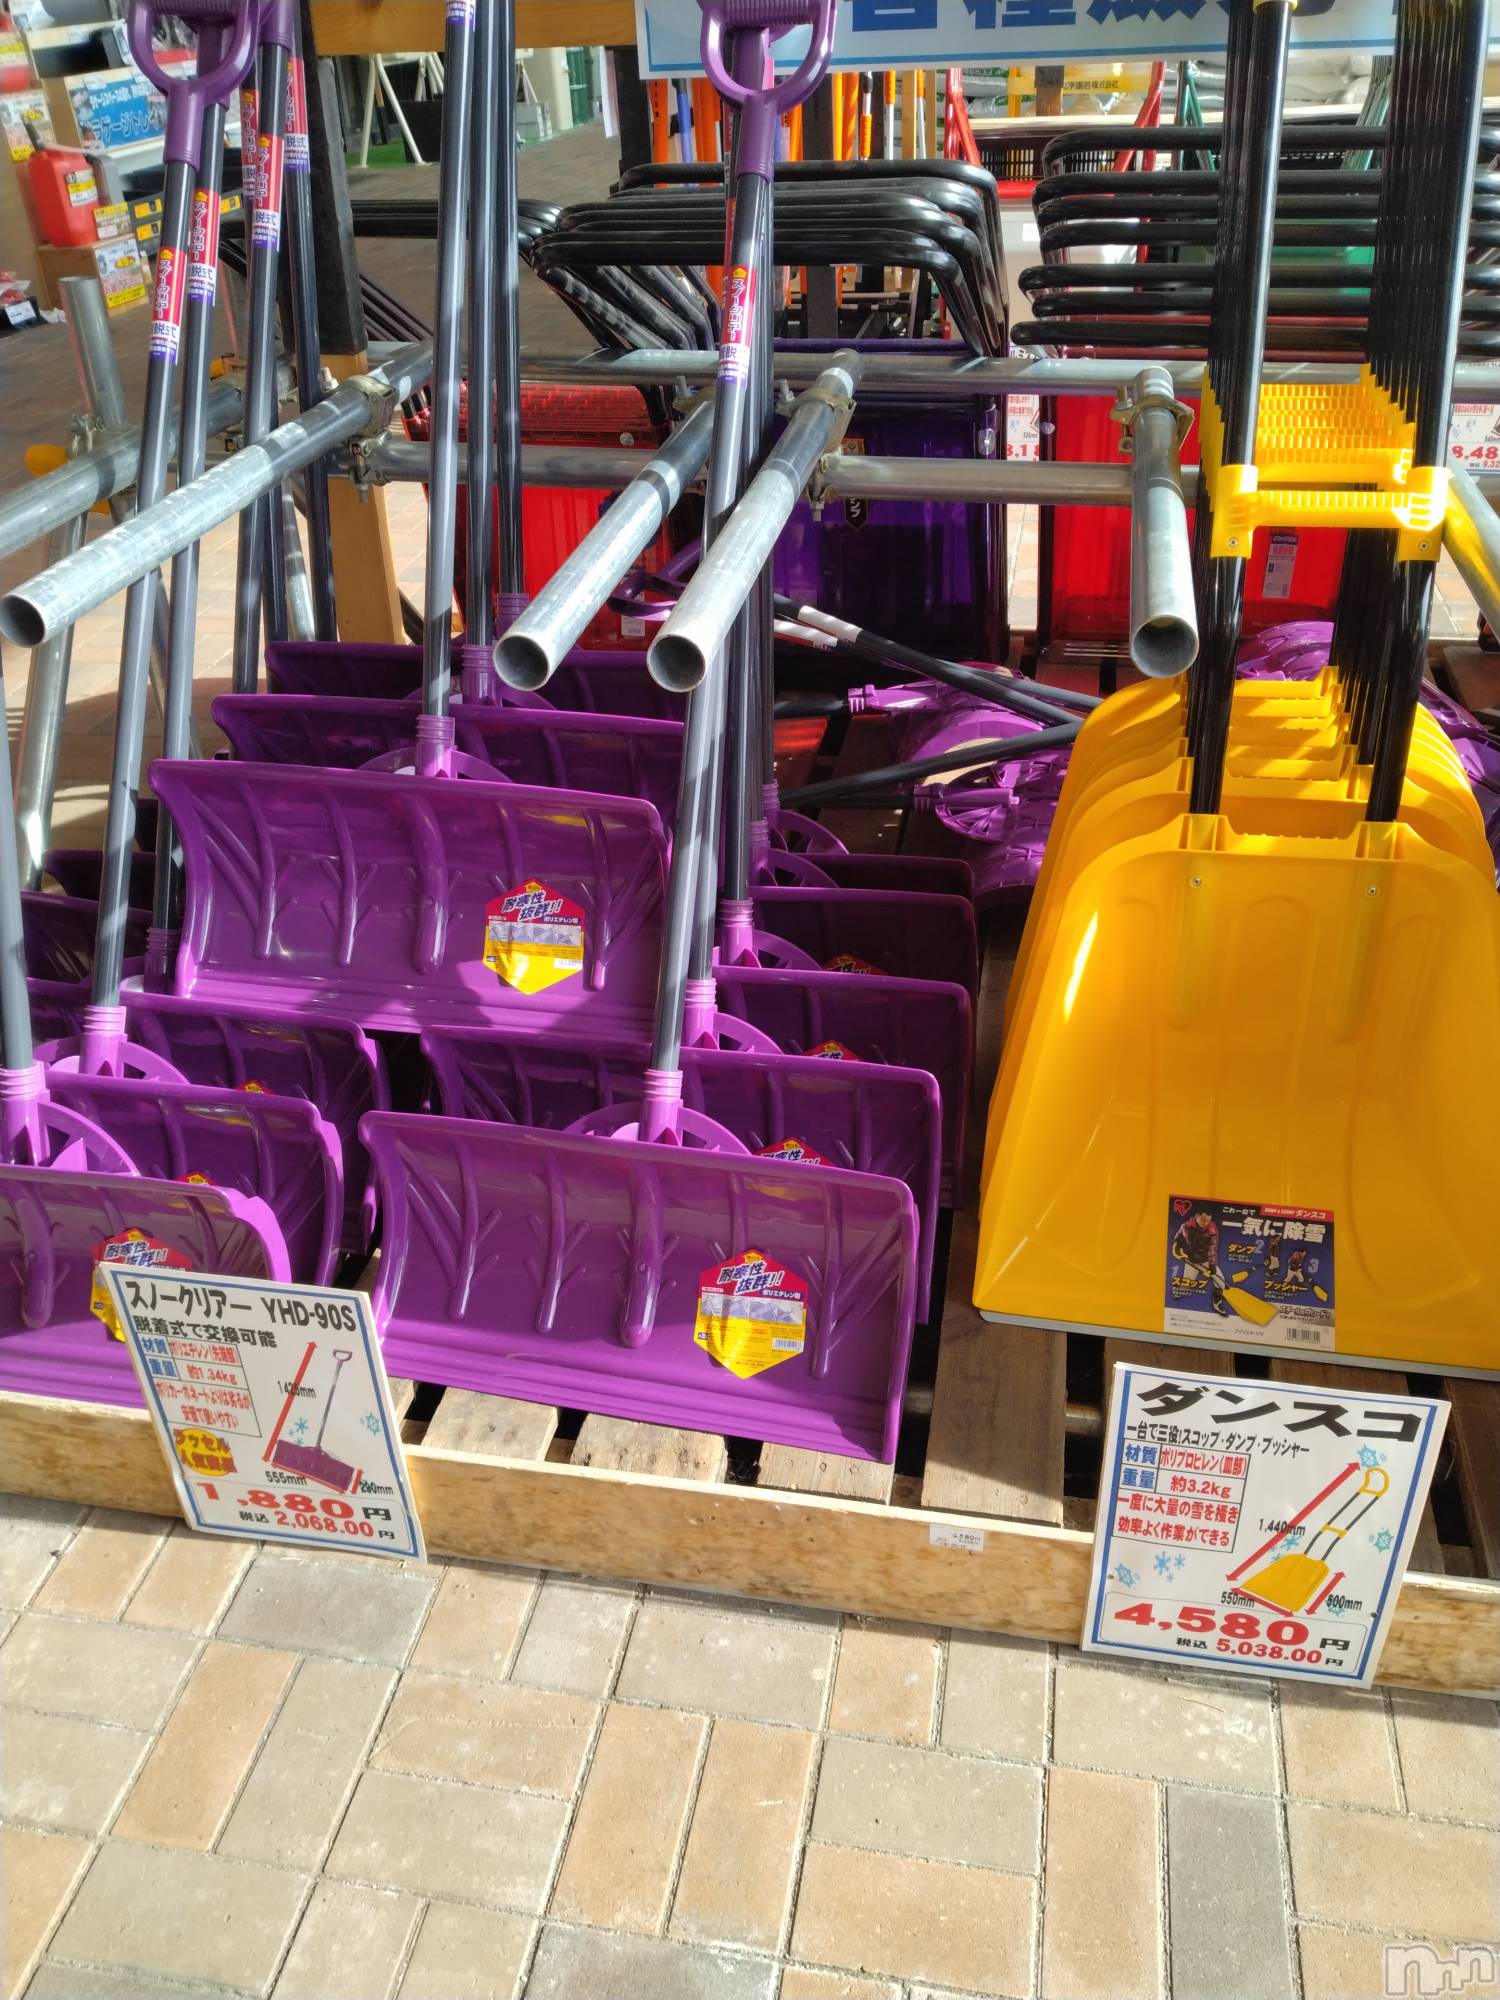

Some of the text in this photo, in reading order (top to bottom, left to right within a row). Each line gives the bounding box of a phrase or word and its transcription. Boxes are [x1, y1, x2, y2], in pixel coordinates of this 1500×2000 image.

[256, 147, 270, 208] スノークリアー
[192, 202, 208, 262] スノークリアー
[155, 259, 172, 319] スノークリアー
[728, 278, 746, 341] スノークリアー
[152, 323, 177, 338] 脱式
[502, 890, 546, 913] 耐寒性
[1222, 1206, 1257, 1216] これ一台で
[1295, 1209, 1327, 1219] ダンスコ
[1222, 1216, 1326, 1243] 一気に除雪
[104, 1240, 149, 1260] 耐寒性
[717, 1260, 767, 1284] 耐寒性
[1308, 1258, 1320, 1273] 3
[734, 1271, 785, 1295] 抜群!!
[1171, 1277, 1208, 1289] スコップ
[1264, 1280, 1309, 1293] プッシャー
[125, 1281, 357, 1332] スノークリアー YHD-90S
[133, 1315, 277, 1348] 脱着式で交換可能
[142, 1337, 169, 1355] 材質
[148, 1358, 177, 1377] 重量
[1136, 1382, 1421, 1442] ダンスコ
[173, 1428, 230, 1454] ラッセル
[1125, 1443, 1248, 1477] 材質 ポリプロピレン(皿部)
[265, 1470, 308, 1487] 555mm
[1121, 1468, 1232, 1499] 重量 約3.2kg
[196, 1482, 392, 1521] 1,880 円
[1117, 1493, 1239, 1524] 一度に大量の雪を掻き
[238, 1510, 395, 1540] 税込 2,068.00 円
[1118, 1516, 1230, 1547] 効率よく作業ができる
[1259, 1518, 1306, 1536] 1,440mm
[1221, 1591, 1255, 1608] 550mm
[1114, 1603, 1351, 1651] 4,580 円
[1176, 1637, 1344, 1667] 税込 5,038.00 円
